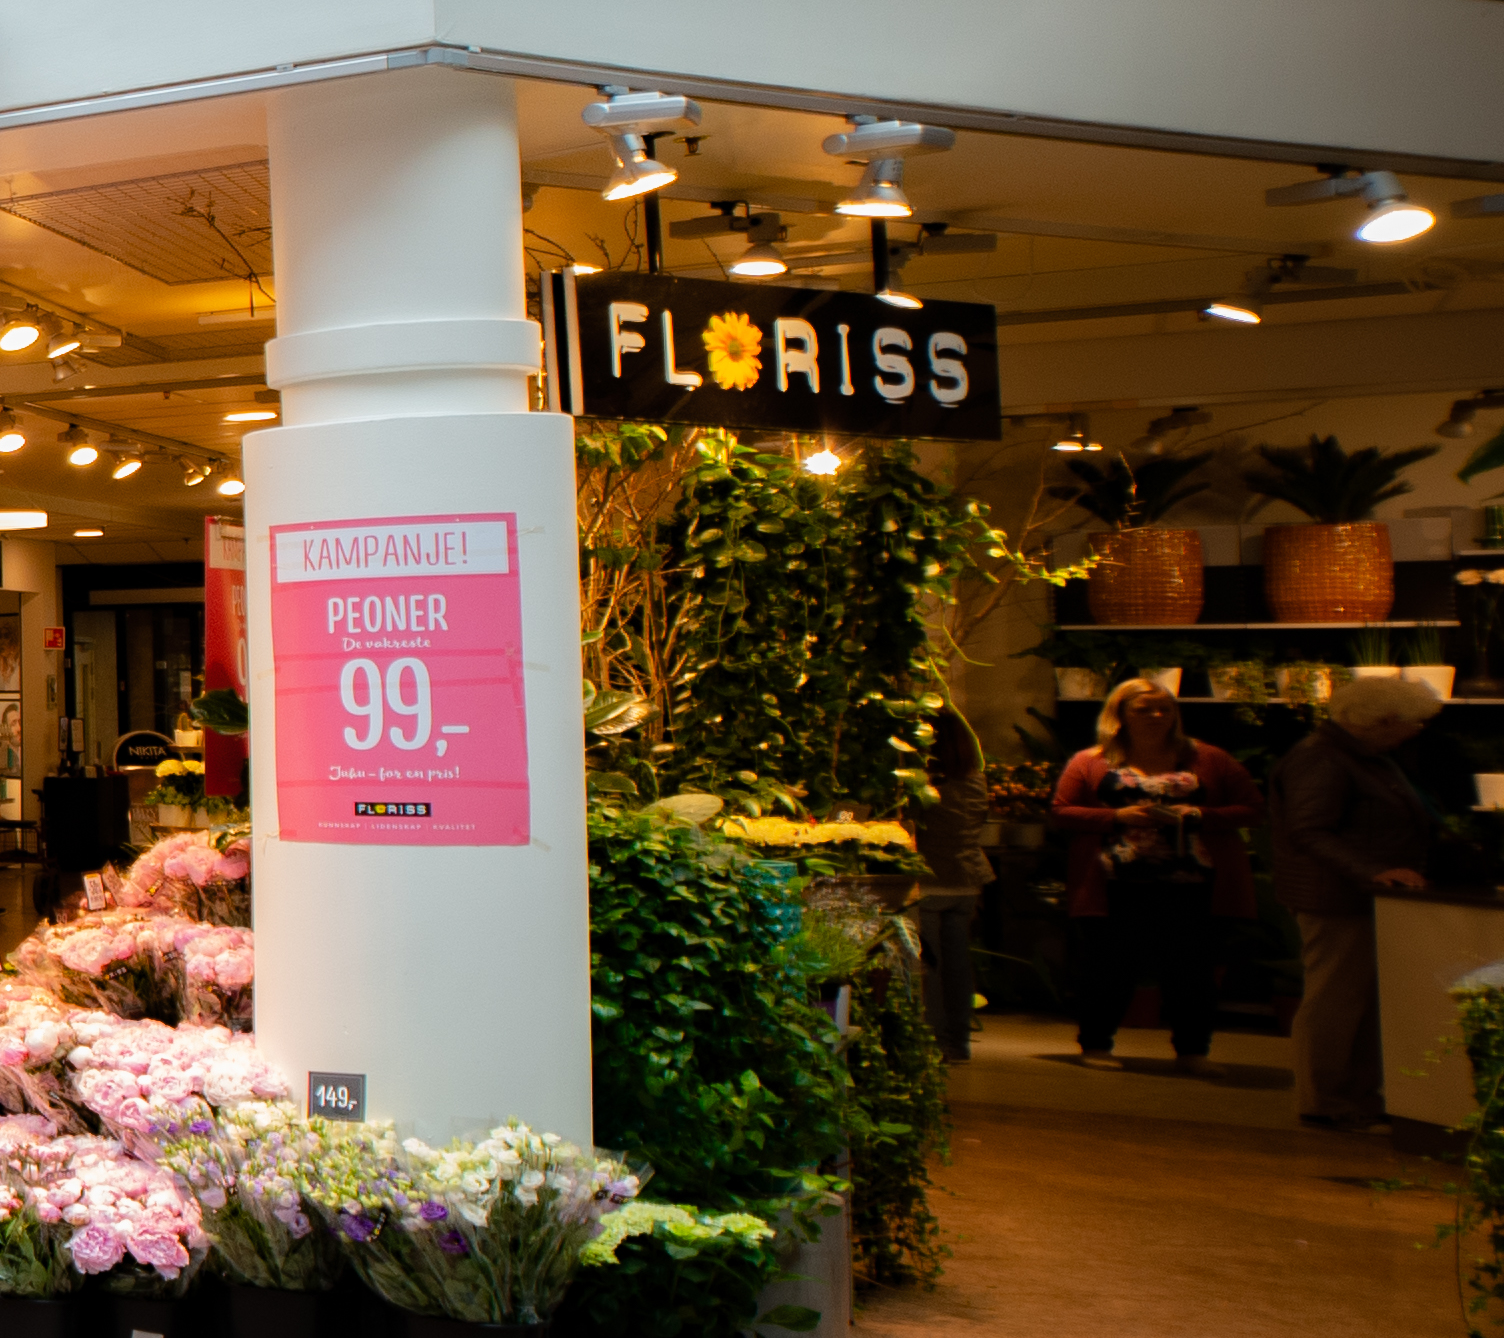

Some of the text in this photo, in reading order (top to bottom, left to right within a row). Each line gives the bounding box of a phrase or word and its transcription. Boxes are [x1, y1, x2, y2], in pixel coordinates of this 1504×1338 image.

[303, 530, 469, 573] KAMPANJE!
[327, 593, 449, 635] PEONER
[342, 636, 363, 653] De
[340, 656, 471, 758] 99,-
[128, 745, 167, 757] NIKITA
[314, 1084, 358, 1111] 149,-
